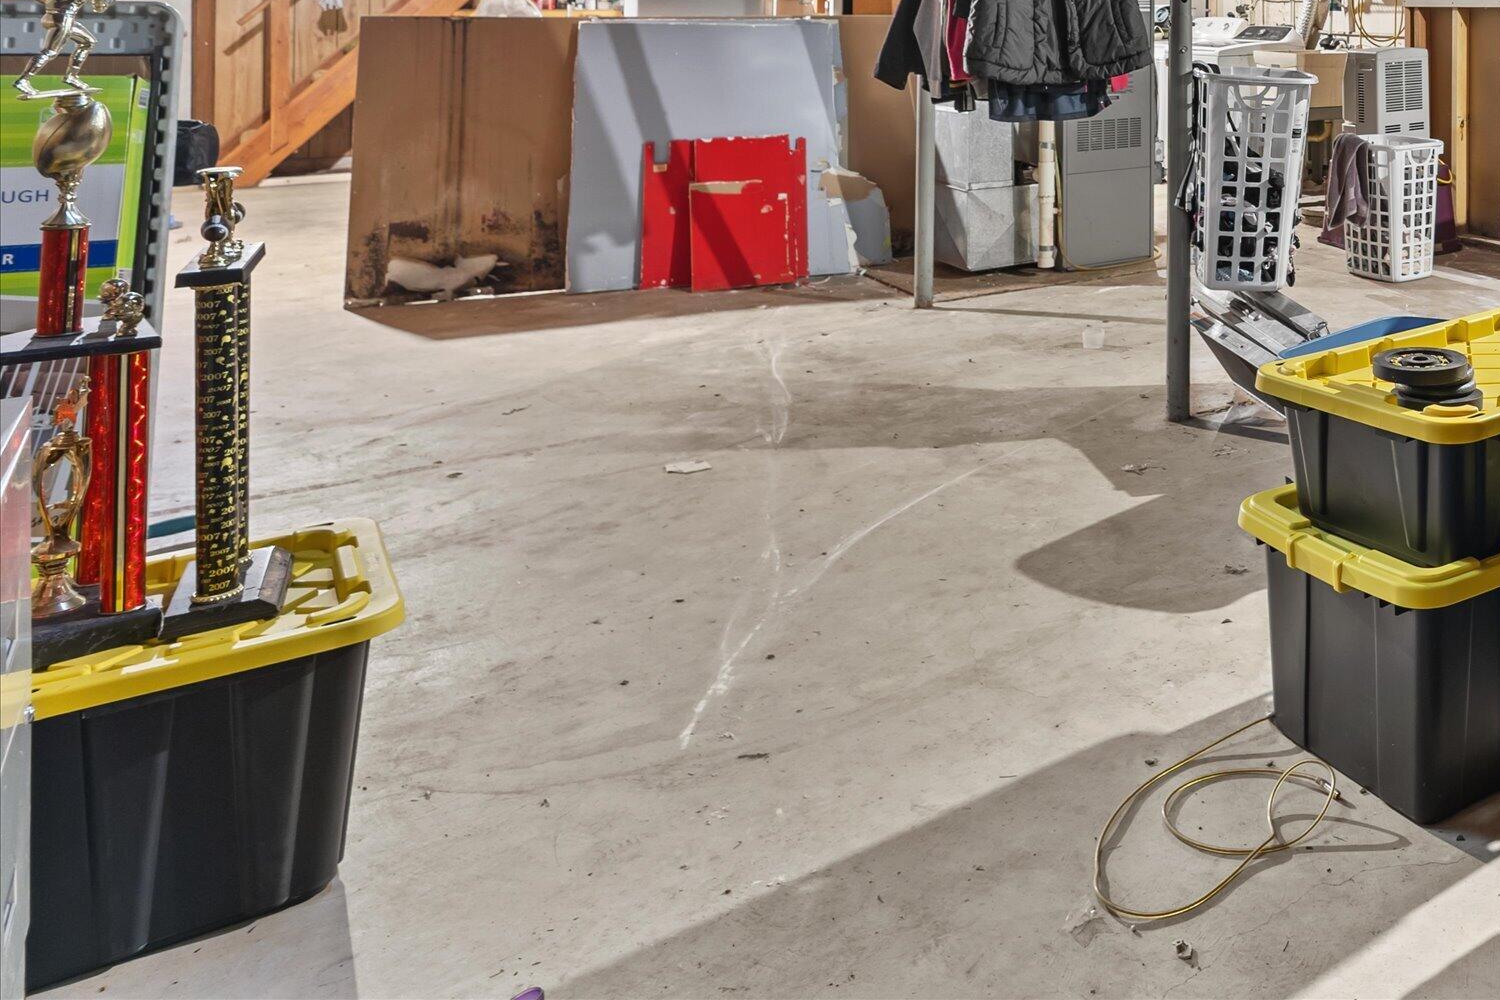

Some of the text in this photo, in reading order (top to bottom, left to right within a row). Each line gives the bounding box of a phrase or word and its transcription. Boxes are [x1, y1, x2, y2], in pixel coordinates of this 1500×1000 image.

[1, 189, 49, 204] UGH
[209, 564, 235, 577] 2007
[209, 580, 231, 592] 2007
